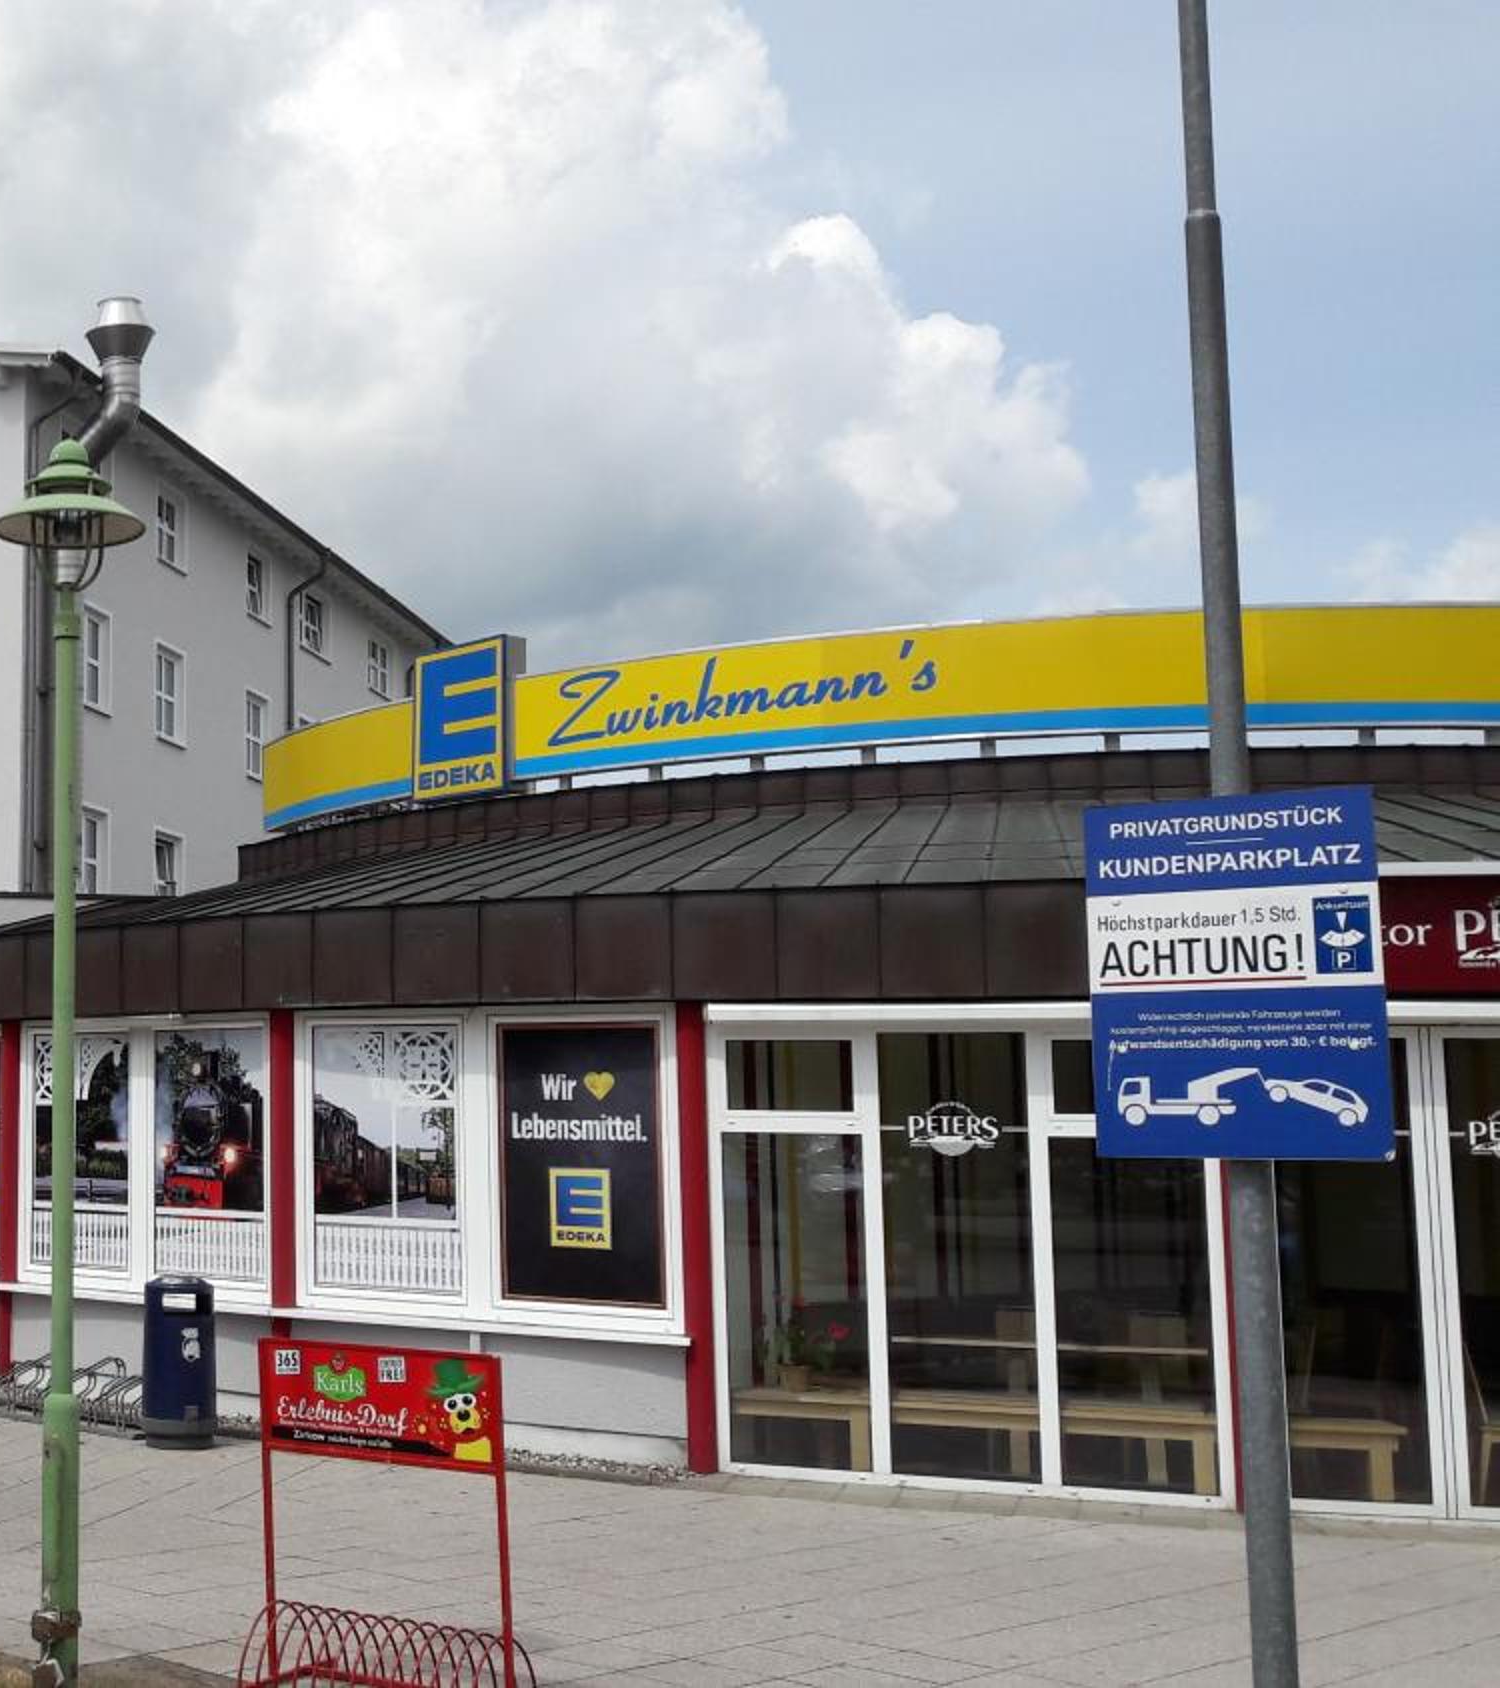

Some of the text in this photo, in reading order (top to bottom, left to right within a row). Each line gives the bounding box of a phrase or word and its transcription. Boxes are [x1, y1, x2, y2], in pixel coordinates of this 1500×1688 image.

[420, 647, 497, 764] E
[548, 639, 938, 748] Zwinkmann's
[419, 762, 495, 790] EDEKA
[1109, 806, 1343, 839] PRIVATGRUNDSTÜCK
[1099, 843, 1362, 879] KUNDENPARKPLATZ
[1098, 906, 1301, 933] Höchstparkdauer 1,5 Std.
[1100, 932, 1304, 979] ACHTUNG!
[1337, 951, 1351, 969] P
[1109, 1037, 1262, 1051] Aufwandsentschädigung
[1264, 1038, 1288, 1047] von
[1318, 1035, 1328, 1047] €
[541, 1073, 577, 1101] Wir
[511, 1112, 647, 1142] Lebensmittel.
[907, 1115, 999, 1140] PETERS
[556, 1229, 606, 1243] EDEKA
[277, 1352, 298, 1367] 365
[316, 1371, 364, 1394] Karls
[277, 1394, 409, 1437] Erlebnis-Dorf
